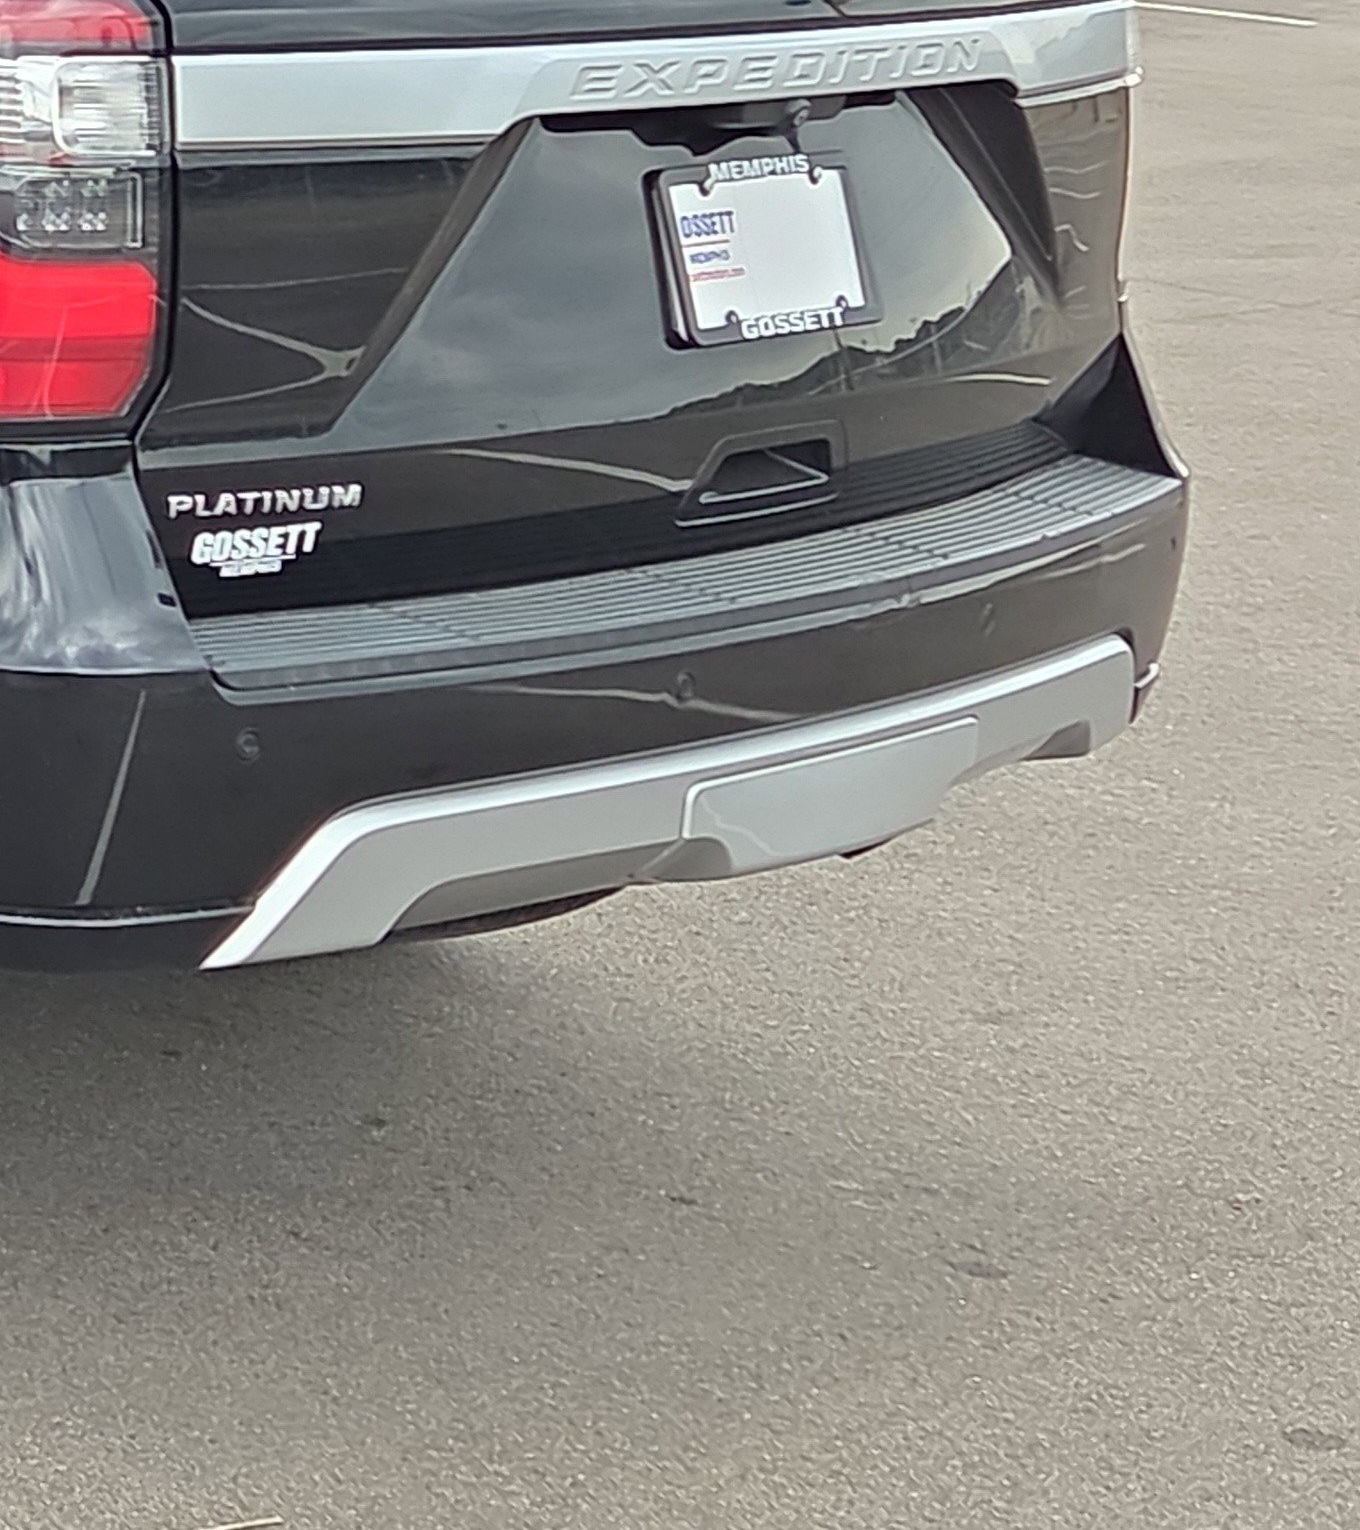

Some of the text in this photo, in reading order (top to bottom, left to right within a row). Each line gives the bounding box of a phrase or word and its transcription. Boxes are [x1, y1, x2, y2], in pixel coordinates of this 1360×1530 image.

[569, 37, 981, 102] EXPEDITION
[708, 154, 810, 182] MEMPHIS
[740, 307, 844, 341] GOSSETT
[166, 483, 364, 519] PLATINUM
[191, 521, 323, 565] GOSSETT
